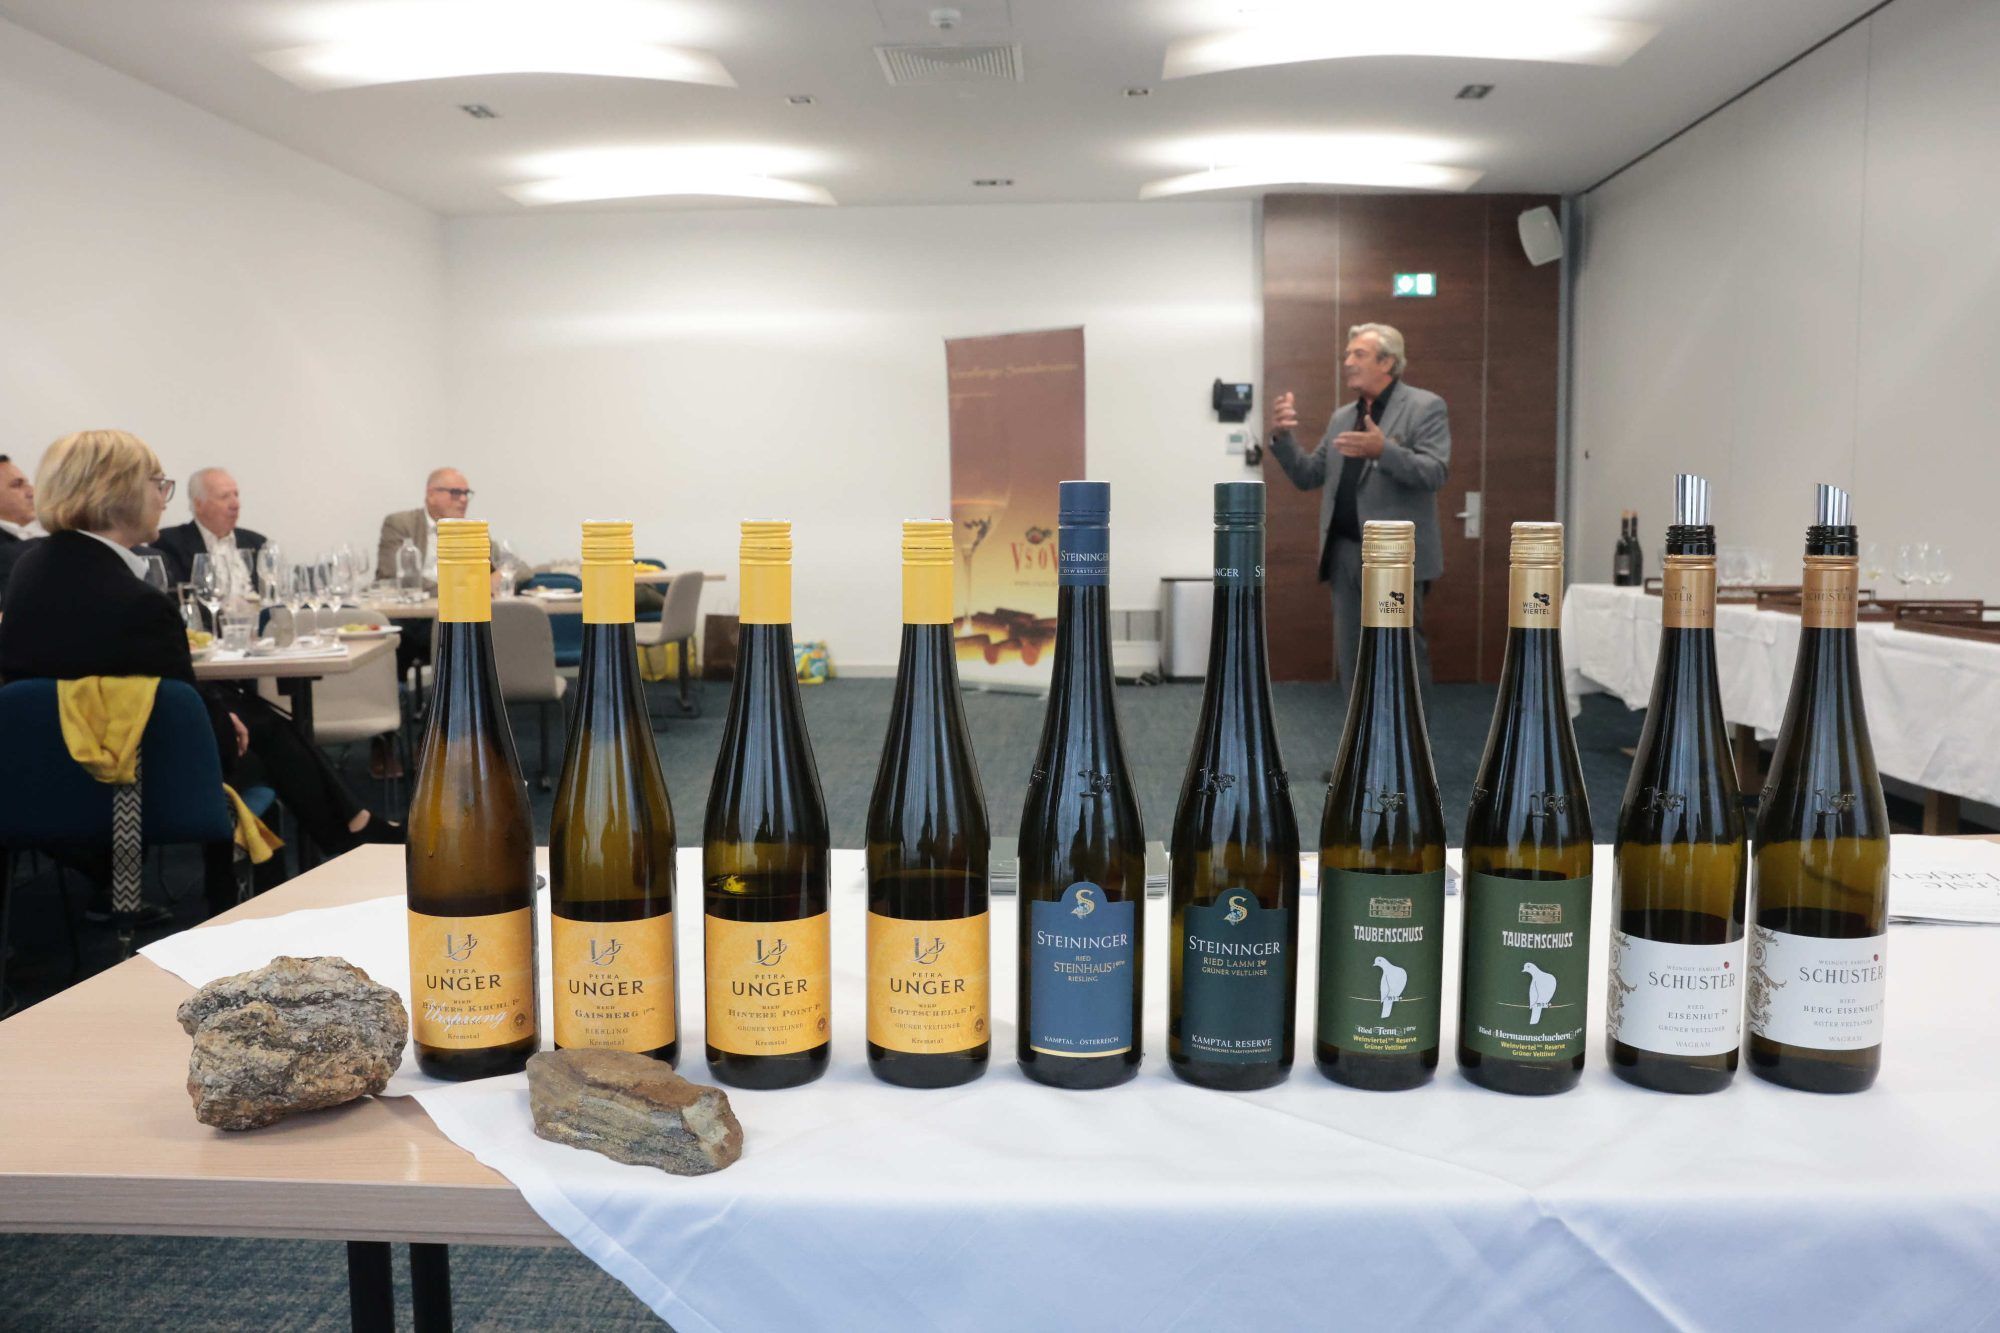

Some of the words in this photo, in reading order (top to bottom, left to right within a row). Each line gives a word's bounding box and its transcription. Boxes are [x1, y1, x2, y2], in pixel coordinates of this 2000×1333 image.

[1037, 930, 1128, 949] STEININGER
[1353, 925, 1424, 943] TAUBENSCHUSS
[1502, 930, 1574, 949] TAUBENSCHUSS
[1189, 935, 1281, 956] STEININGER
[1054, 961, 1112, 974] STEINHAUS
[1203, 956, 1224, 967] RIED
[1226, 959, 1255, 968] LAMM
[1201, 966, 1230, 976] GRÜNER
[1799, 965, 1884, 984] SCHUSTER
[426, 974, 501, 991] UNGER
[1067, 975, 1099, 983] RIESLING
[1648, 971, 1736, 990] SCHUSTER
[569, 979, 644, 997] UNGER
[732, 979, 808, 997] UNGER
[890, 977, 965, 995] UNGER
[575, 1009, 639, 1019] GAISBERG
[728, 1009, 777, 1019] HINTERE
[1803, 1005, 1832, 1014] BERG
[1837, 1003, 1879, 1015] EISENHUT
[1668, 1012, 1719, 1020] EISENHUT
[1356, 1025, 1373, 1034] Ried
[1374, 1026, 1398, 1036] Tenn
[1044, 1035, 1074, 1045] KAMPTAL
[1191, 1033, 1233, 1048] KAMPTAL
[1235, 1038, 1272, 1048] RESERVE
[1353, 1034, 1388, 1043] Weinviertel
[1395, 1036, 1417, 1044] Reserve
[1501, 1041, 1537, 1050] Weinviertel
[1544, 1043, 1566, 1051] Reserve
